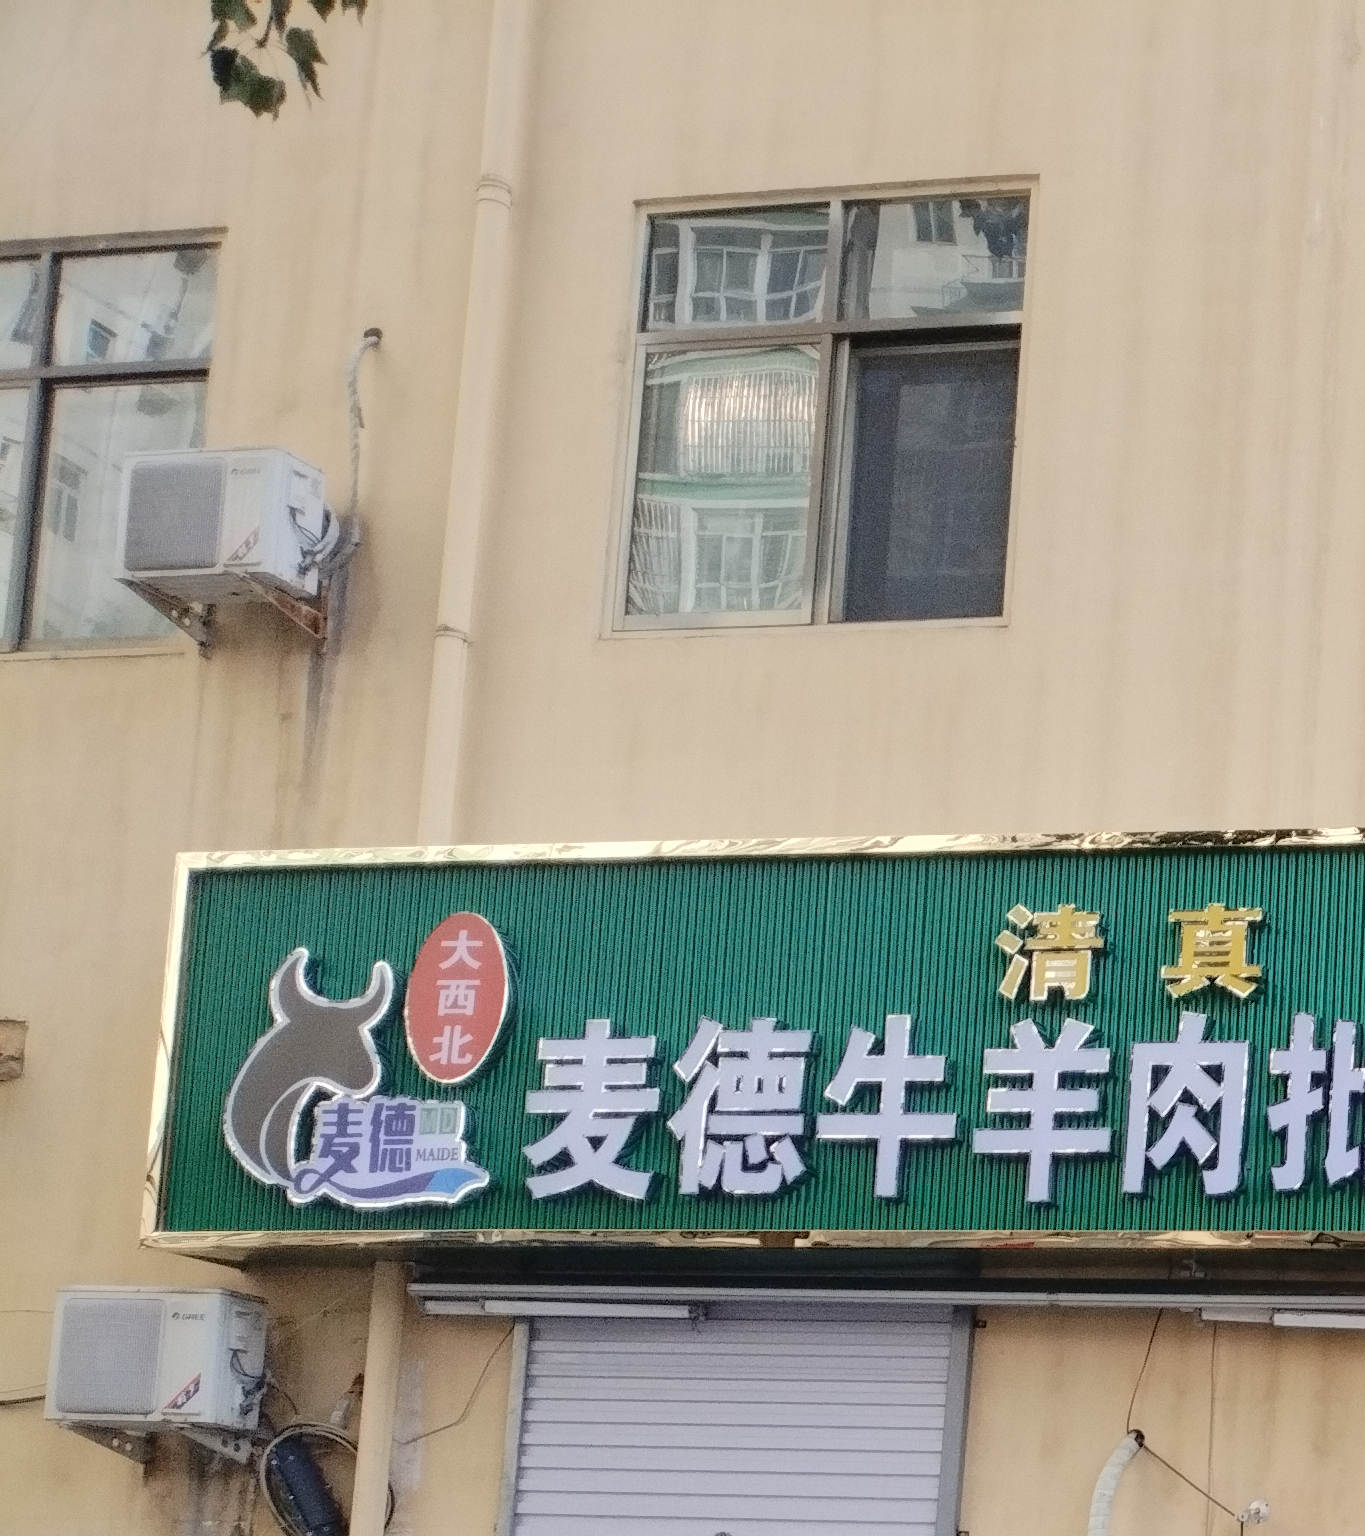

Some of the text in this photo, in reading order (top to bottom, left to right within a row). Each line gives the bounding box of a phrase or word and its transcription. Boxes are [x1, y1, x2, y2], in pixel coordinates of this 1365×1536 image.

[995, 903, 1263, 1001] 清真
[429, 930, 484, 1065] 大西北
[312, 1102, 416, 1180] 麦德
[415, 1147, 460, 1162] MAIDE
